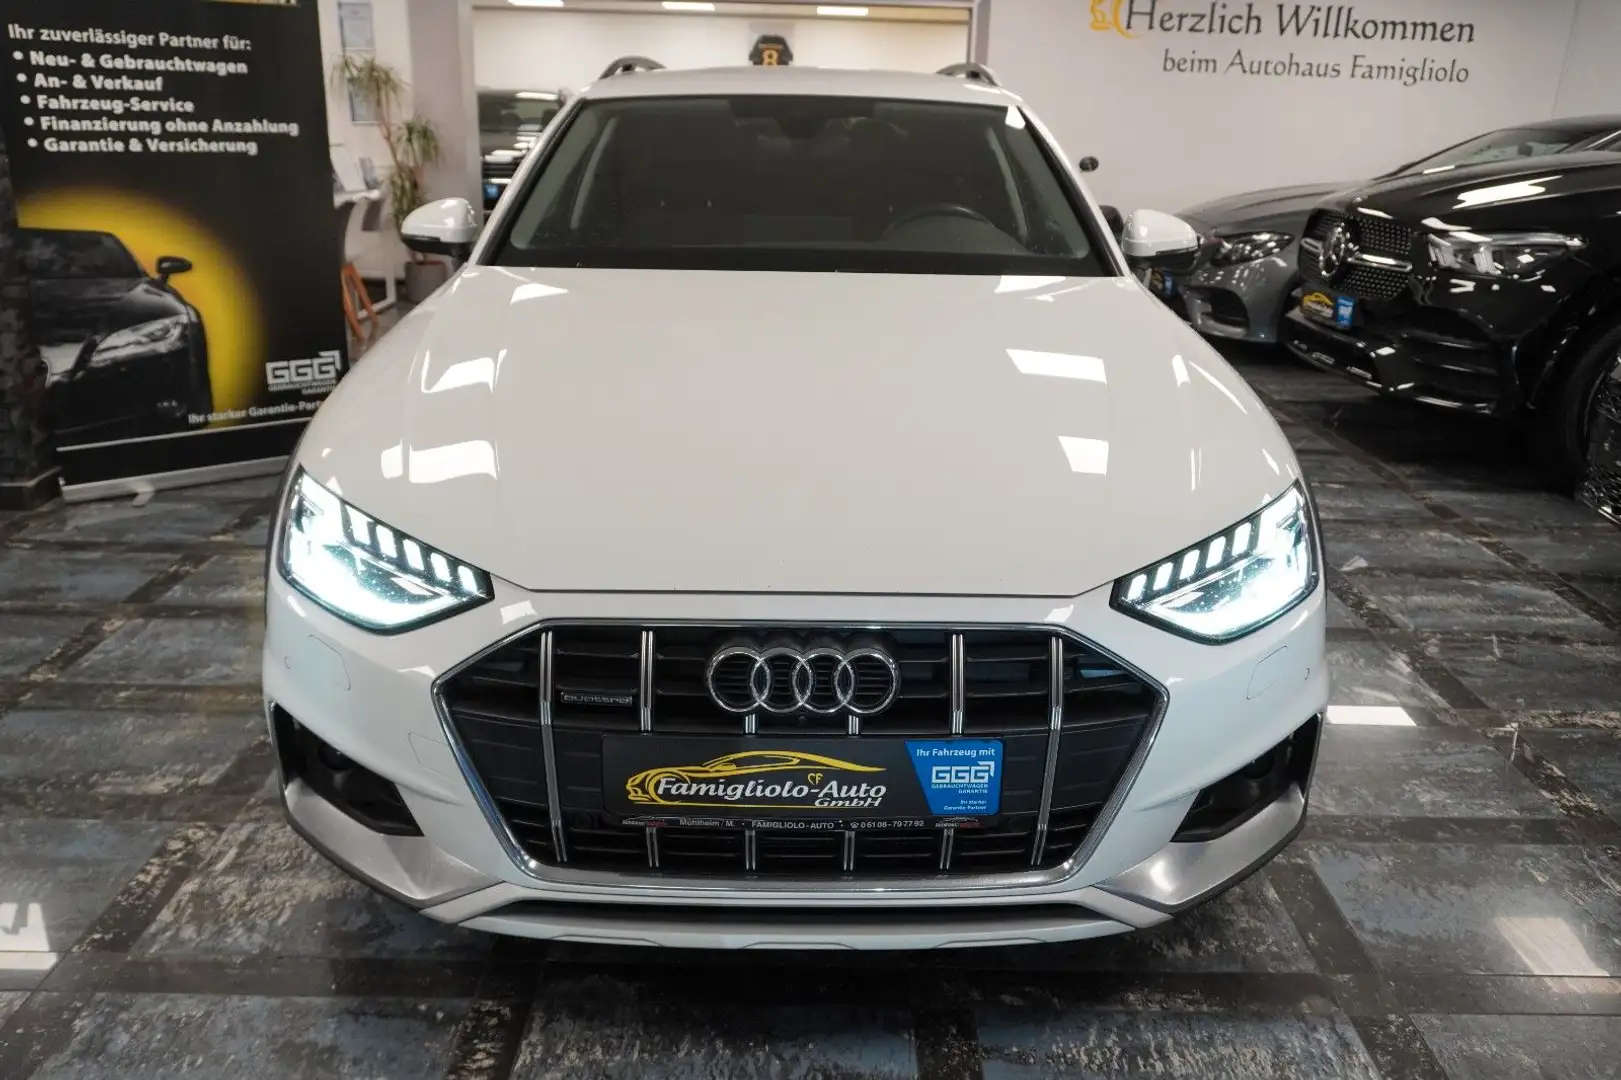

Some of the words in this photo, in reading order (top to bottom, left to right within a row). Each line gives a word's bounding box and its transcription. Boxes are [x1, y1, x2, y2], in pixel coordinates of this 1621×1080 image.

[1126, 0, 1262, 35] Herzlich
[1276, 3, 1475, 43] Willkommen
[8, 23, 35, 40] Ihr
[40, 28, 155, 49] zuverlässiger
[158, 32, 219, 49] Partner
[222, 34, 252, 50] für:
[29, 50, 77, 67] Neu-
[81, 52, 95, 68] &
[99, 53, 248, 76] Gebrauchtwagen
[1162, 48, 1217, 73] beim
[1223, 49, 1341, 78] Autohaus
[1350, 54, 1469, 87] Famigliolo
[34, 72, 68, 88] An-
[72, 74, 87, 89] &
[90, 74, 163, 91] Verkauf
[36, 94, 195, 114] Fahrzeug-Service
[40, 115, 161, 135] Finanzierung
[165, 117, 208, 133] ohne
[212, 118, 299, 137] Anzahlung
[44, 137, 125, 152] Garantie
[128, 138, 143, 152] &
[146, 137, 258, 156] Versicherung
[265, 355, 338, 385] GGG
[916, 748, 930, 757] Ihr
[932, 748, 977, 758] Fahrzeug
[979, 747, 996, 757] mit
[931, 765, 989, 783] GGG
[657, 777, 887, 801] Famigliolo-Auto
[814, 797, 883, 808] GmbH
